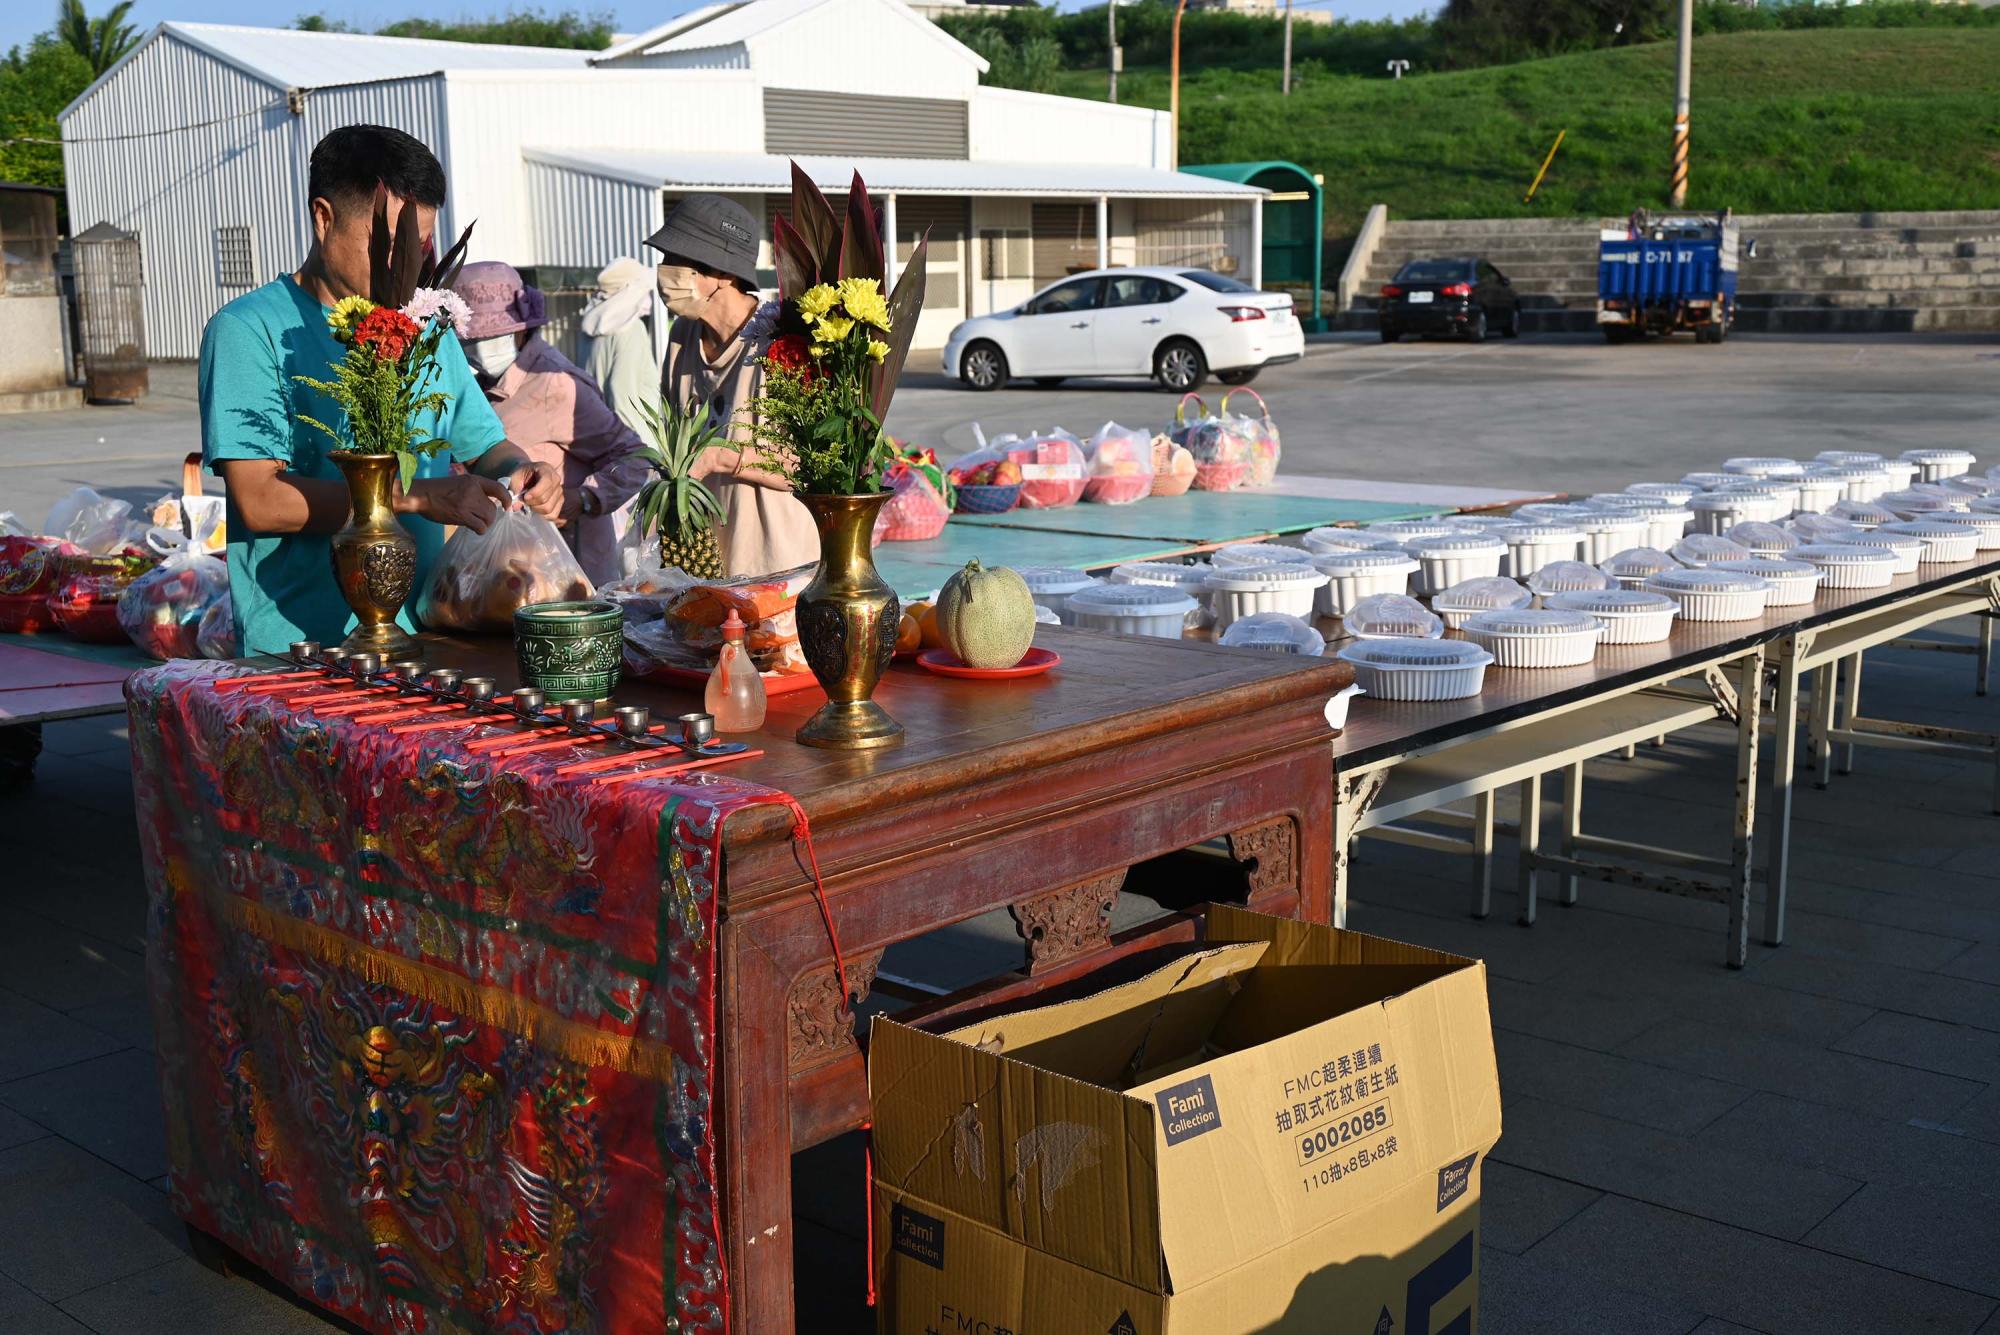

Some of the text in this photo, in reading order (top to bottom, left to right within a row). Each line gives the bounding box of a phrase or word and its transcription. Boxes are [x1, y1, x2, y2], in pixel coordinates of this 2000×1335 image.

[1283, 1043, 1383, 1099] FMC超柔連續
[1168, 1087, 1205, 1117] Fami
[1275, 1064, 1399, 1133] 抽取式花紋衛生紙
[1168, 1112, 1215, 1135] Collection
[1301, 1105, 1387, 1159] 9002085
[1444, 1162, 1468, 1187] Fami
[1439, 1178, 1466, 1203] Collection
[901, 1215, 934, 1243] Fami
[896, 1233, 939, 1261] Collection
